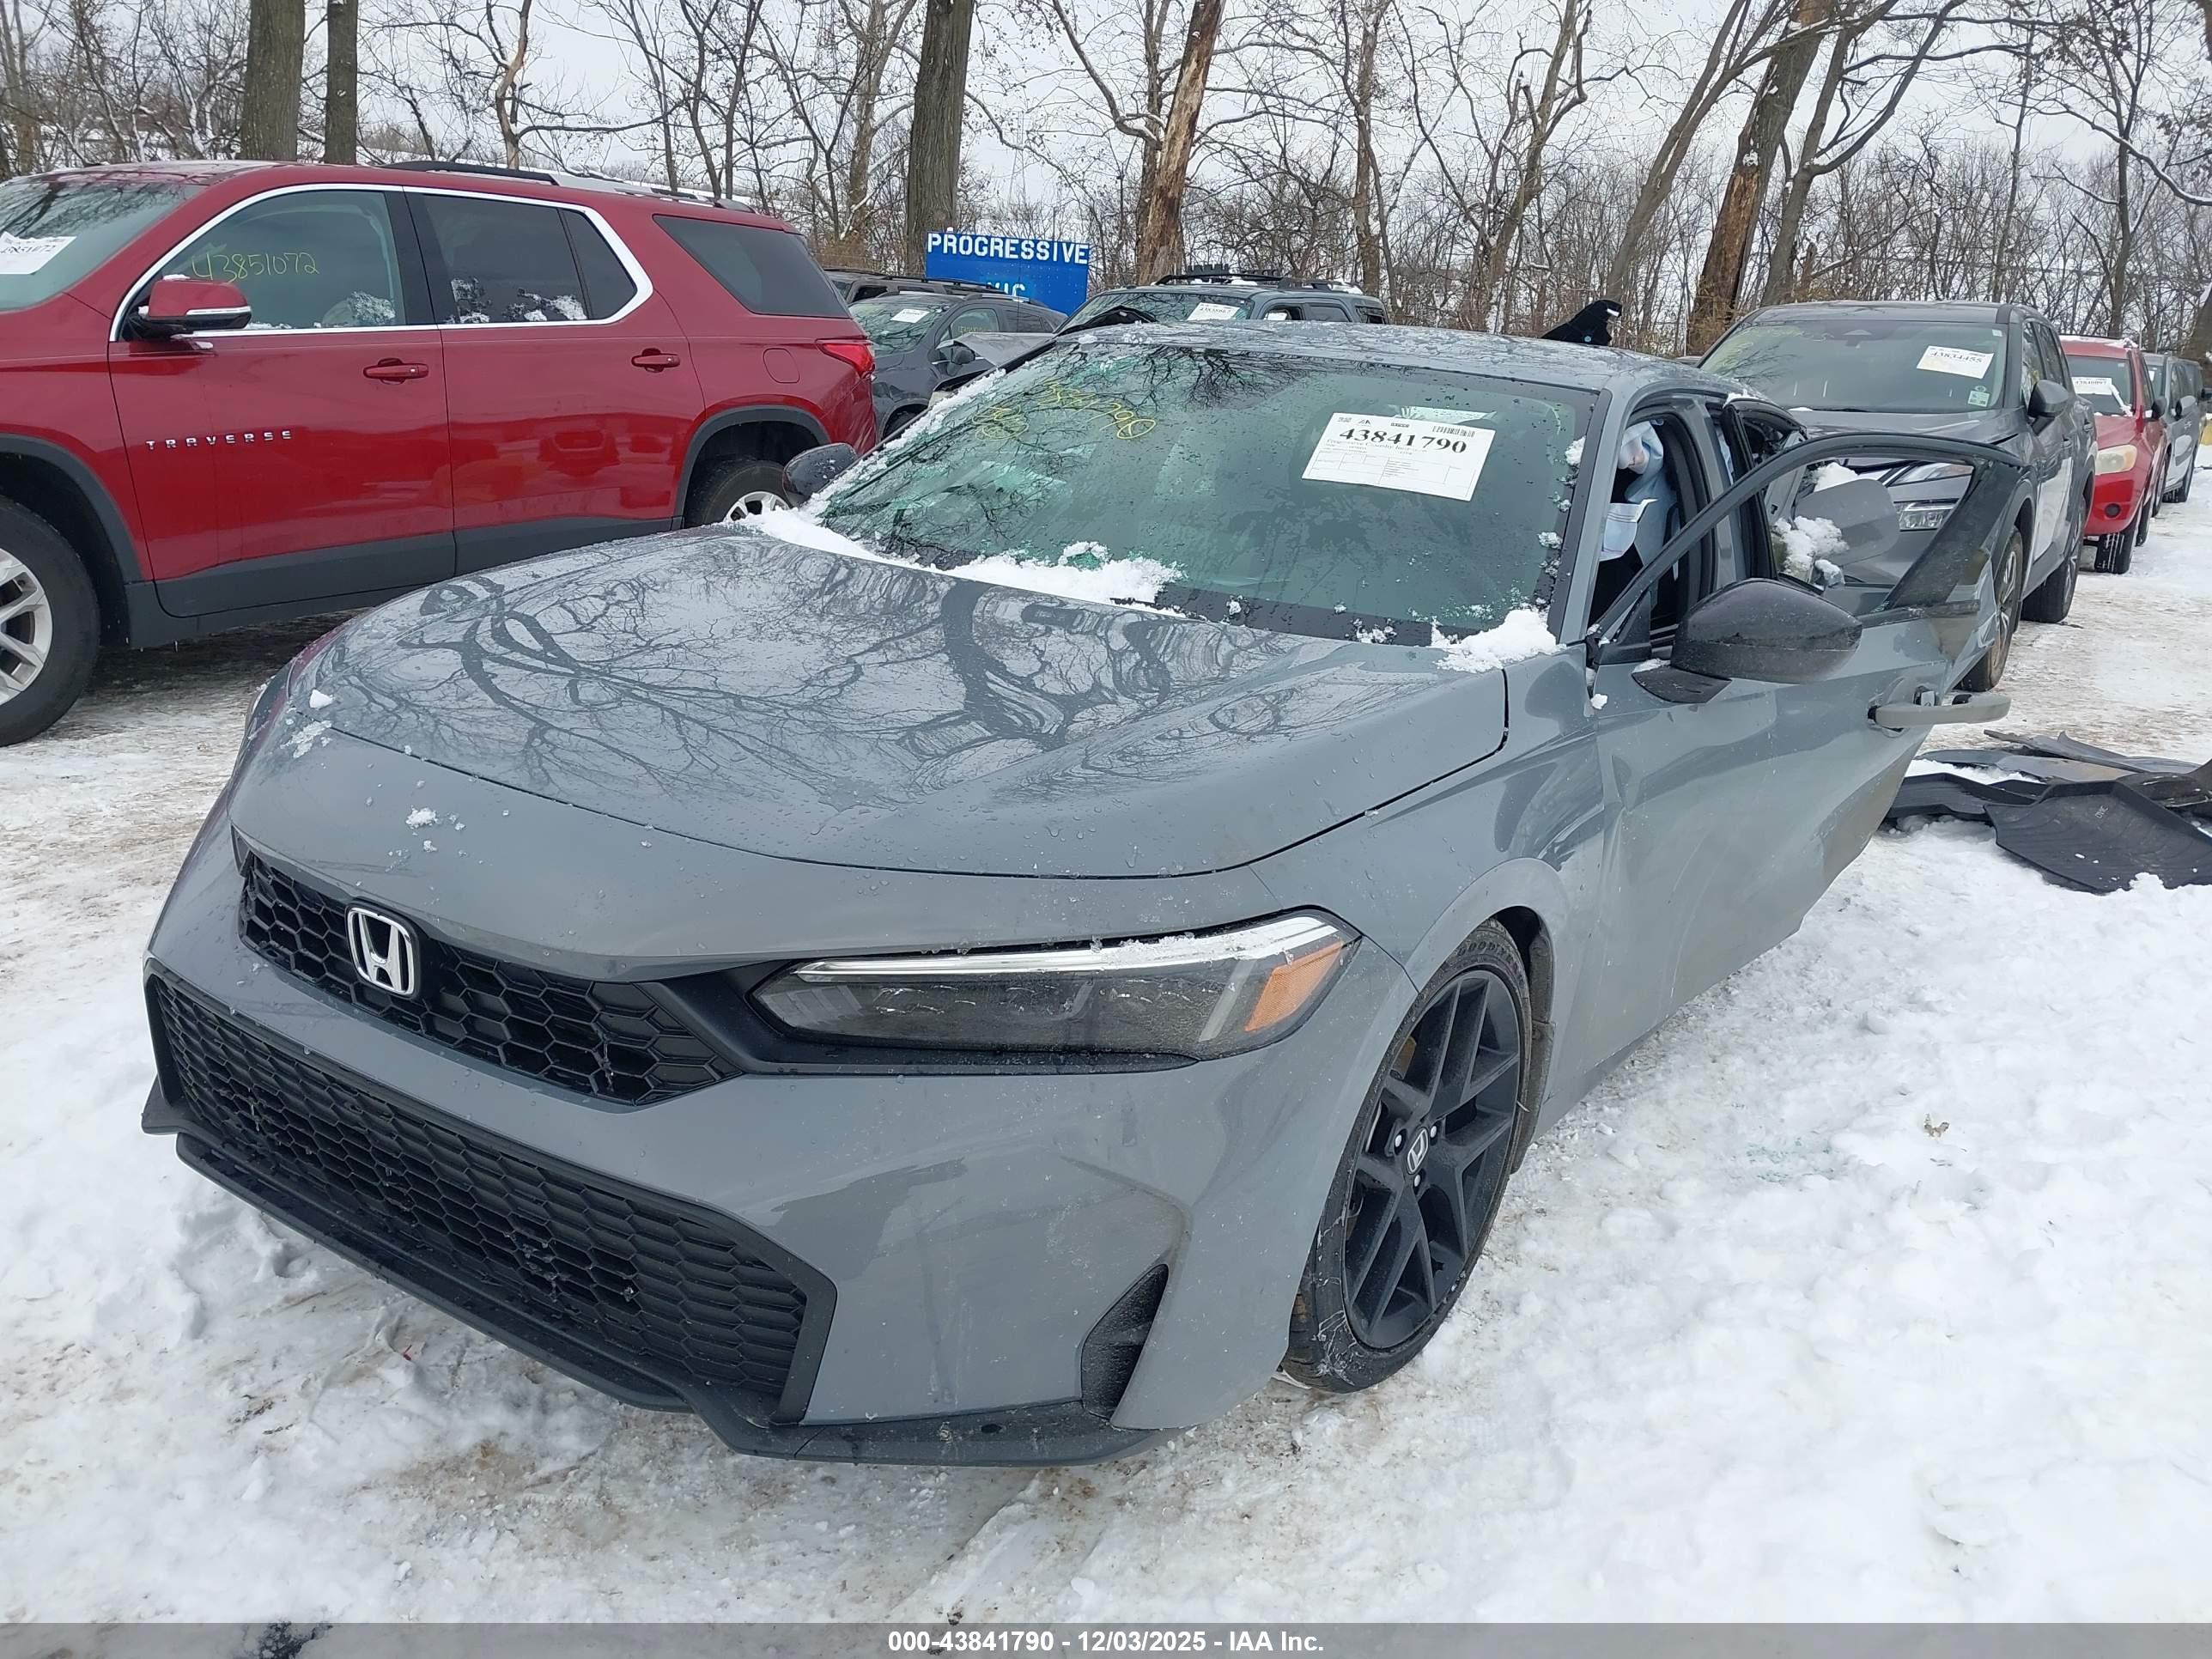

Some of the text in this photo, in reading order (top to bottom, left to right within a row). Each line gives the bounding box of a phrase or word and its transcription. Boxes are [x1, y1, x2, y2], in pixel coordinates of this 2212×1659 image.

[927, 233, 1088, 265] PROGRESSIVE
[191, 252, 320, 284] 43851072
[145, 430, 293, 451] TRAVERSE
[1340, 428, 1468, 453] 43841790
